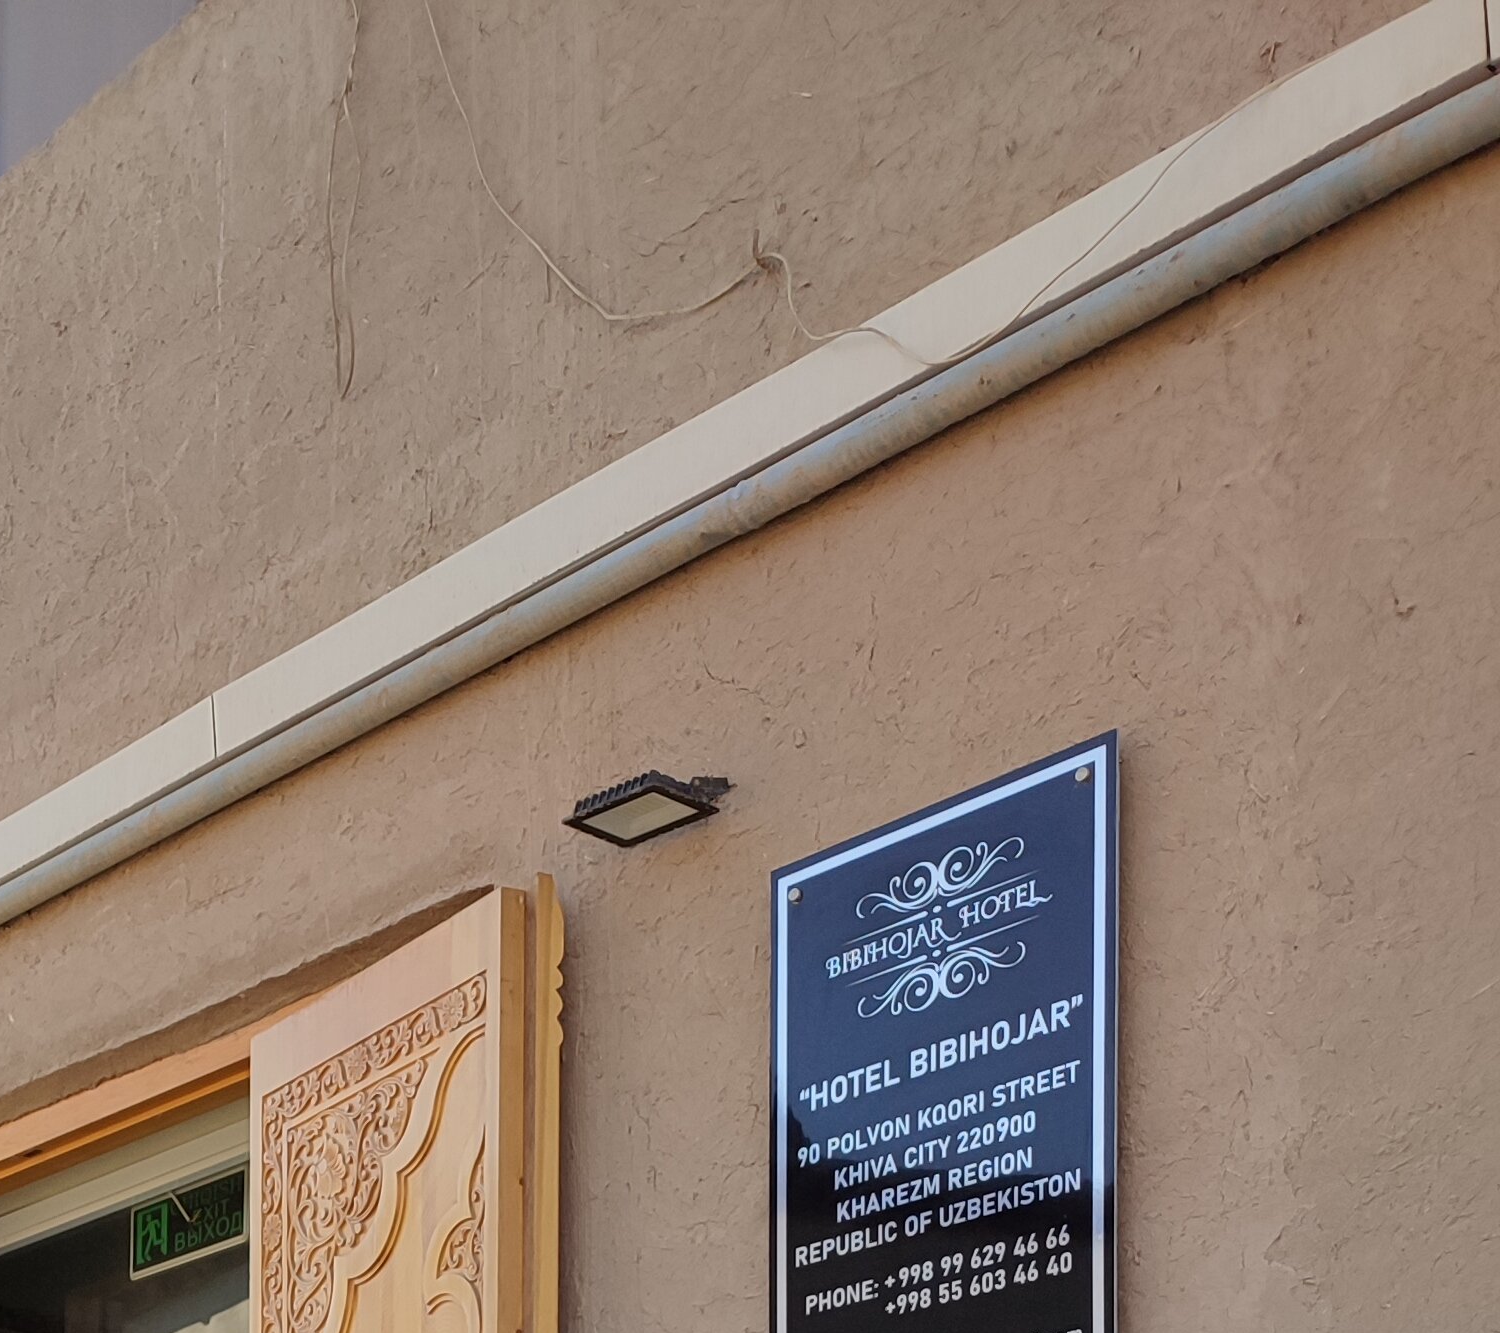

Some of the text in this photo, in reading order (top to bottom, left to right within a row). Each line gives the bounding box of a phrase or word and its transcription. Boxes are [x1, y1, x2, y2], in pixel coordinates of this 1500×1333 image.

[825, 880, 1053, 979] BIBIHOJAR HOTEL
[797, 1141, 820, 1168] 90
[827, 1113, 910, 1160] POLVON
[991, 1060, 1081, 1107] STREET
[834, 1110, 1036, 1191] KHIVA CITY 220900
[795, 1168, 1081, 1268] REPUBLIC OF UZBEKISTON
[836, 1146, 1033, 1223] KHAREZM REGION
[174, 1211, 243, 1252] ВЫХОД
[805, 1224, 1071, 1316] PHONE: +998 99 629 46 66
[884, 1251, 1072, 1315] +998 55 603 46 40
